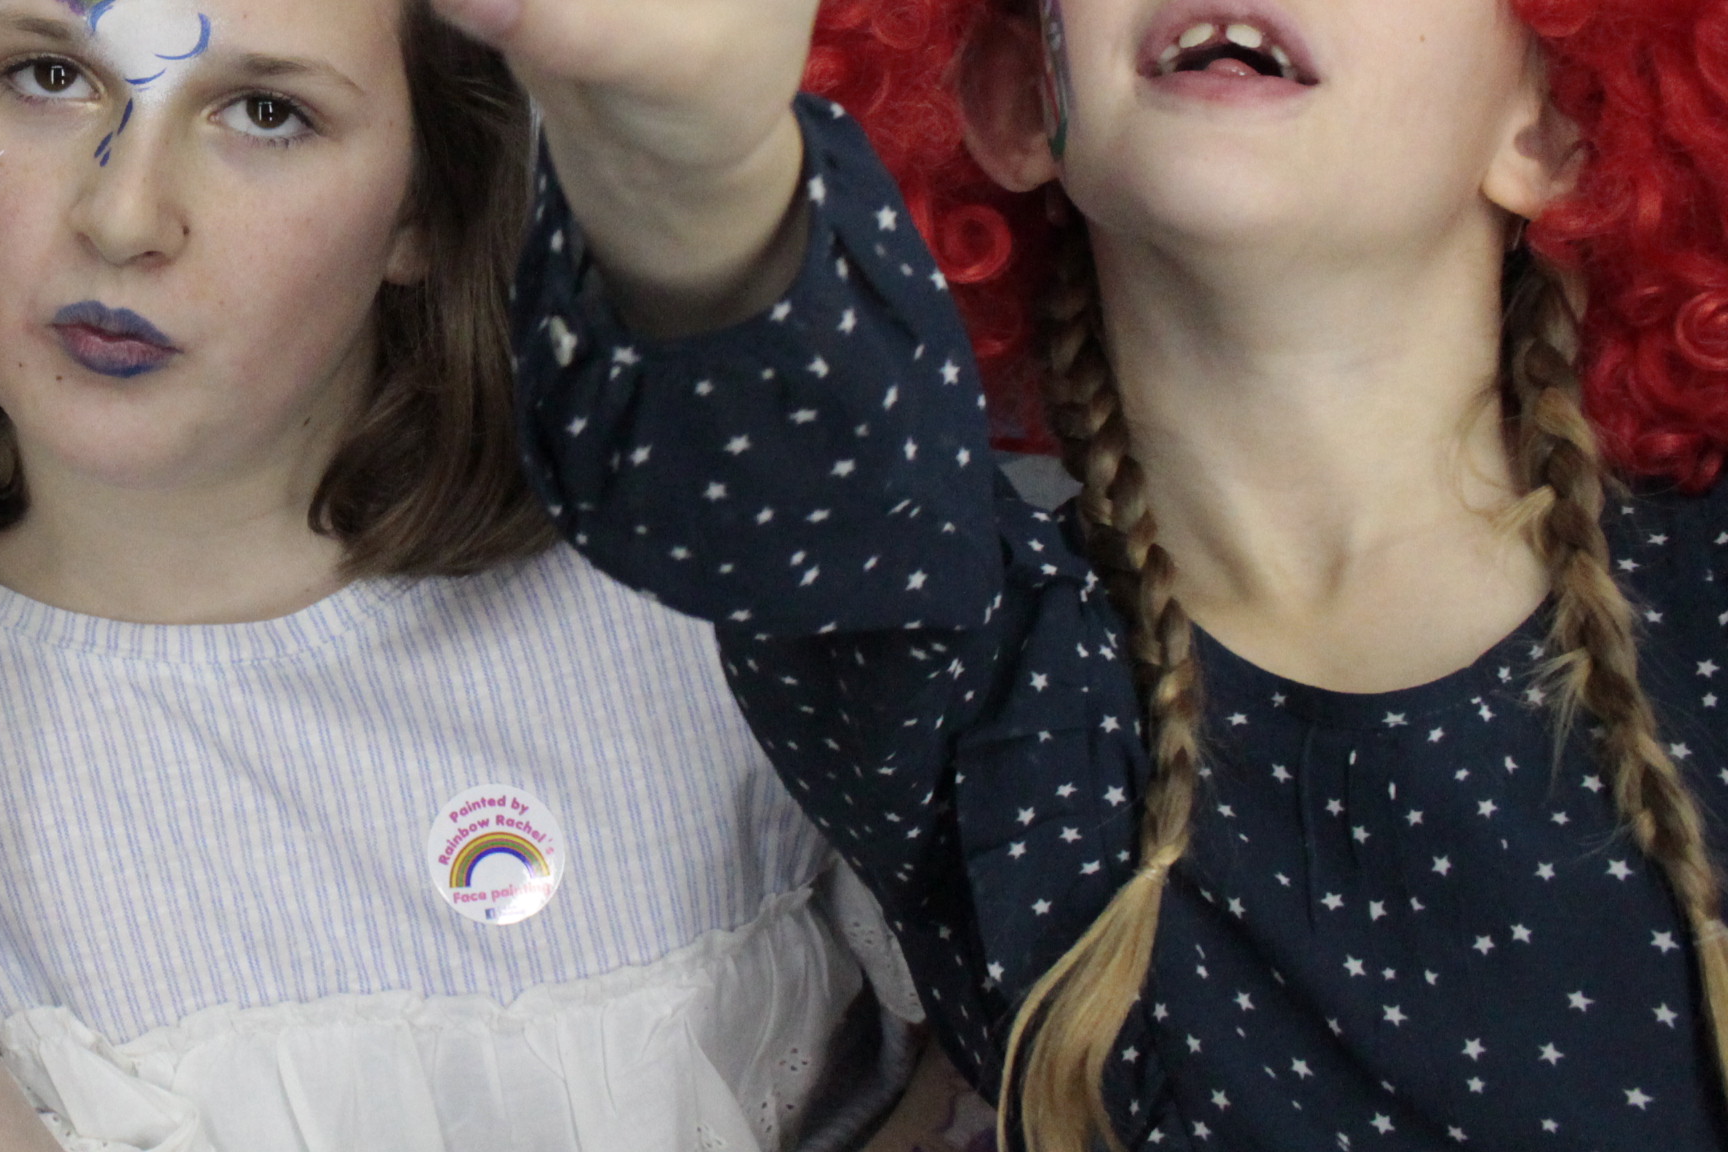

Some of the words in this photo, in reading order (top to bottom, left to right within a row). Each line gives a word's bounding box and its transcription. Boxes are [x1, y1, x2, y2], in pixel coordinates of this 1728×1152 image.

[449, 795, 506, 823] Painted
[510, 797, 529, 816] by
[438, 817, 490, 865] Rainbow
[453, 890, 487, 904] Face
